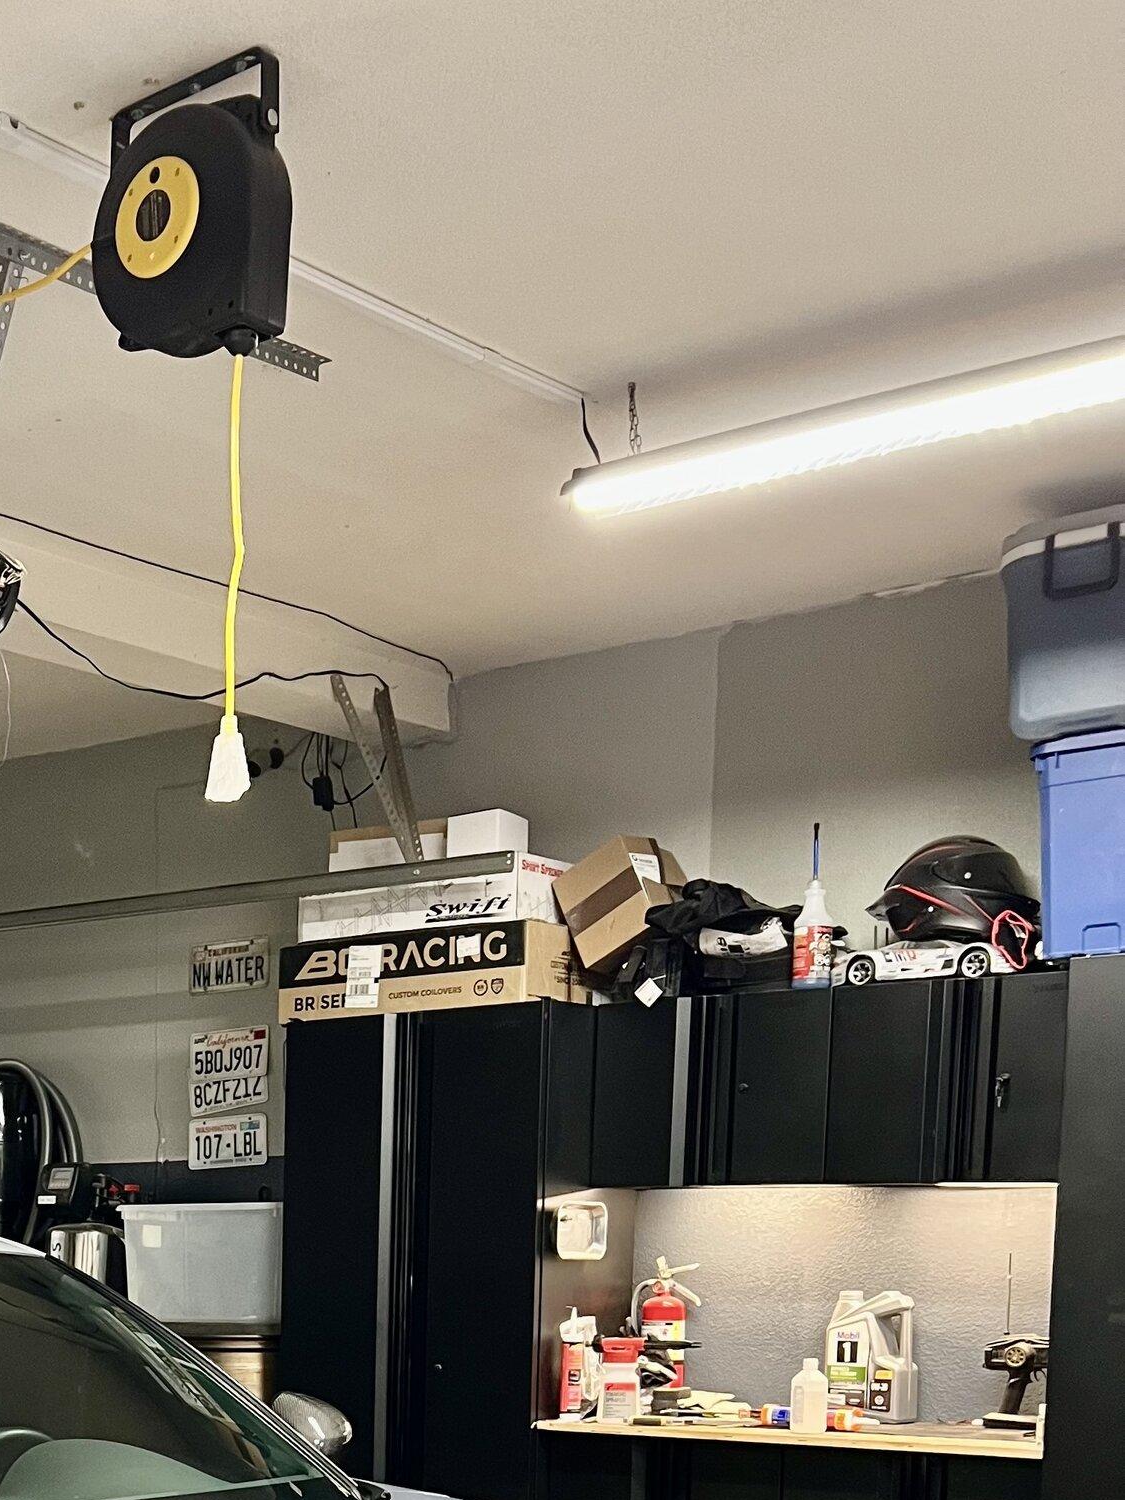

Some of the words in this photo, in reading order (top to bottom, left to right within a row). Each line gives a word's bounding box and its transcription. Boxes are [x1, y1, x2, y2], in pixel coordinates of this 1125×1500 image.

[215, 955, 265, 986] WATER
[294, 997, 315, 1012] BR
[388, 990, 419, 1000] CUSTOM
[420, 986, 463, 998] COILOVERS
[195, 1123, 238, 1134] WASHINGTON
[837, 1331, 860, 1339] Mobil
